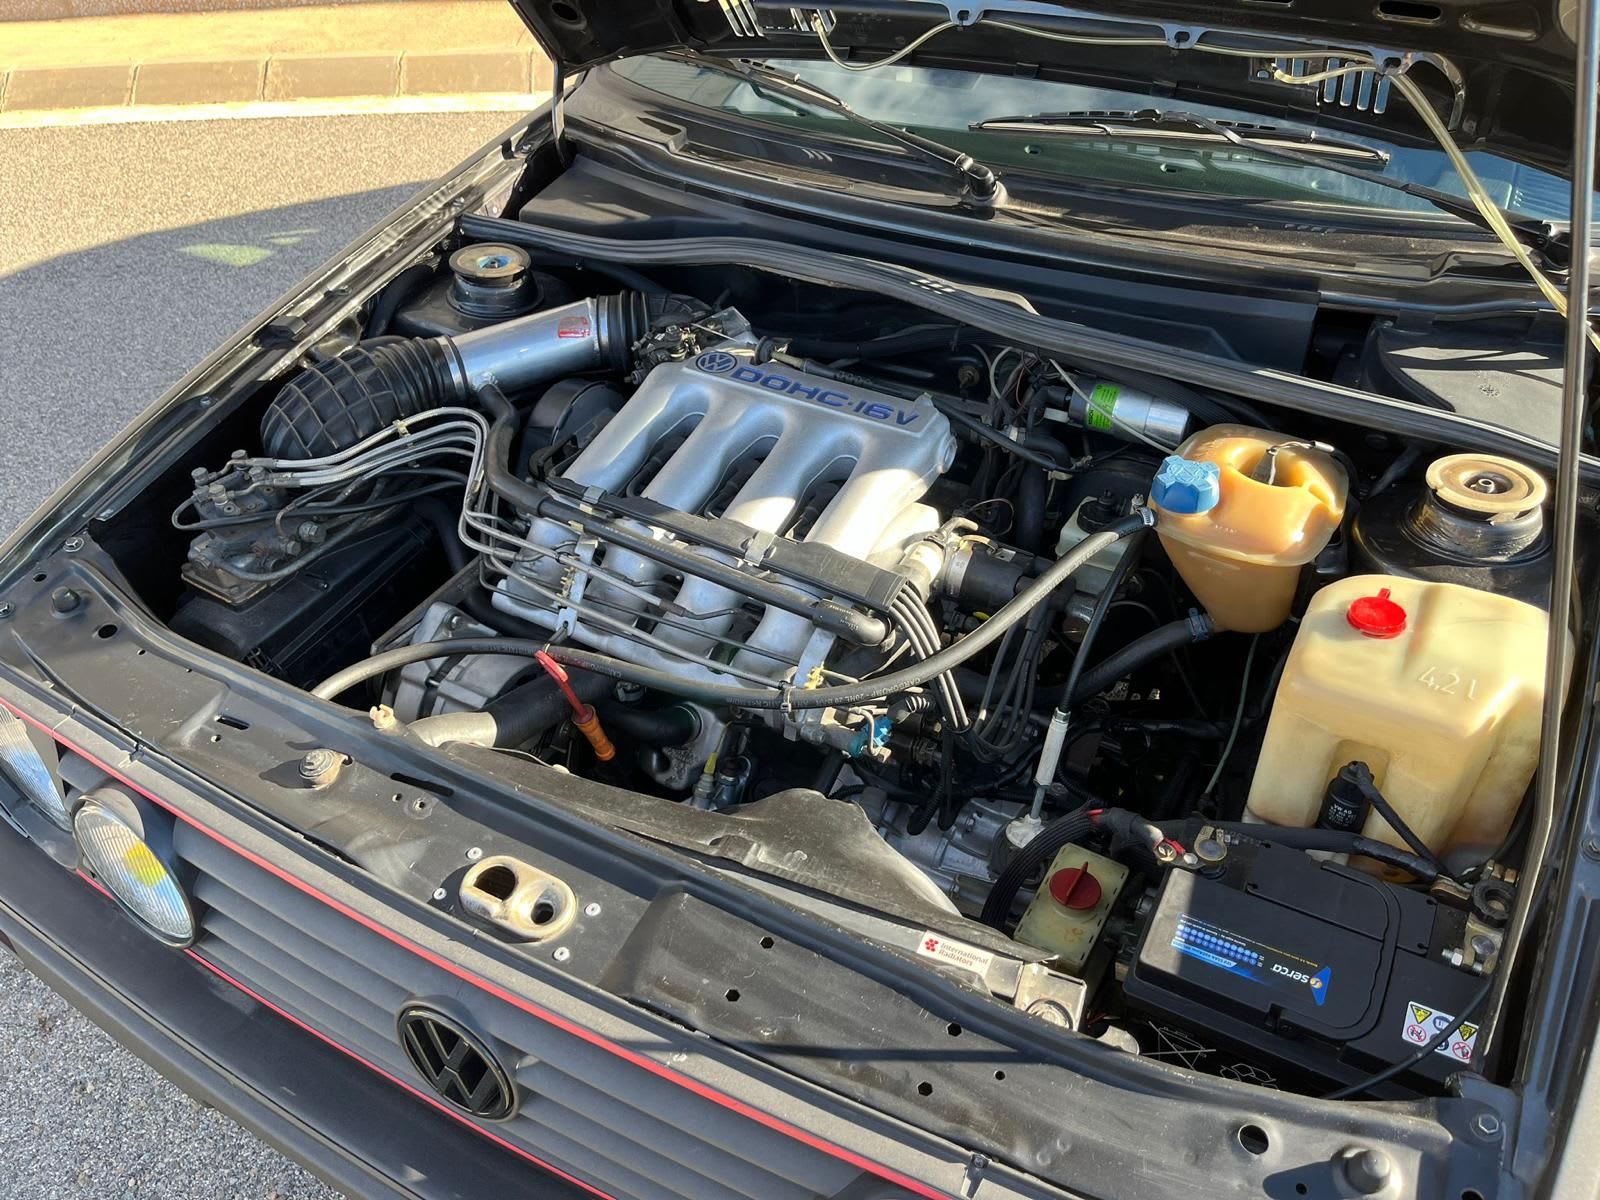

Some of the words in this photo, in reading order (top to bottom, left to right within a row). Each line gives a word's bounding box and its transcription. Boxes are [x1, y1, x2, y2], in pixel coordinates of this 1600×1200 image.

[939, 949, 973, 967] Radiators
[940, 942, 989, 965] International
[1272, 963, 1311, 985] serca
